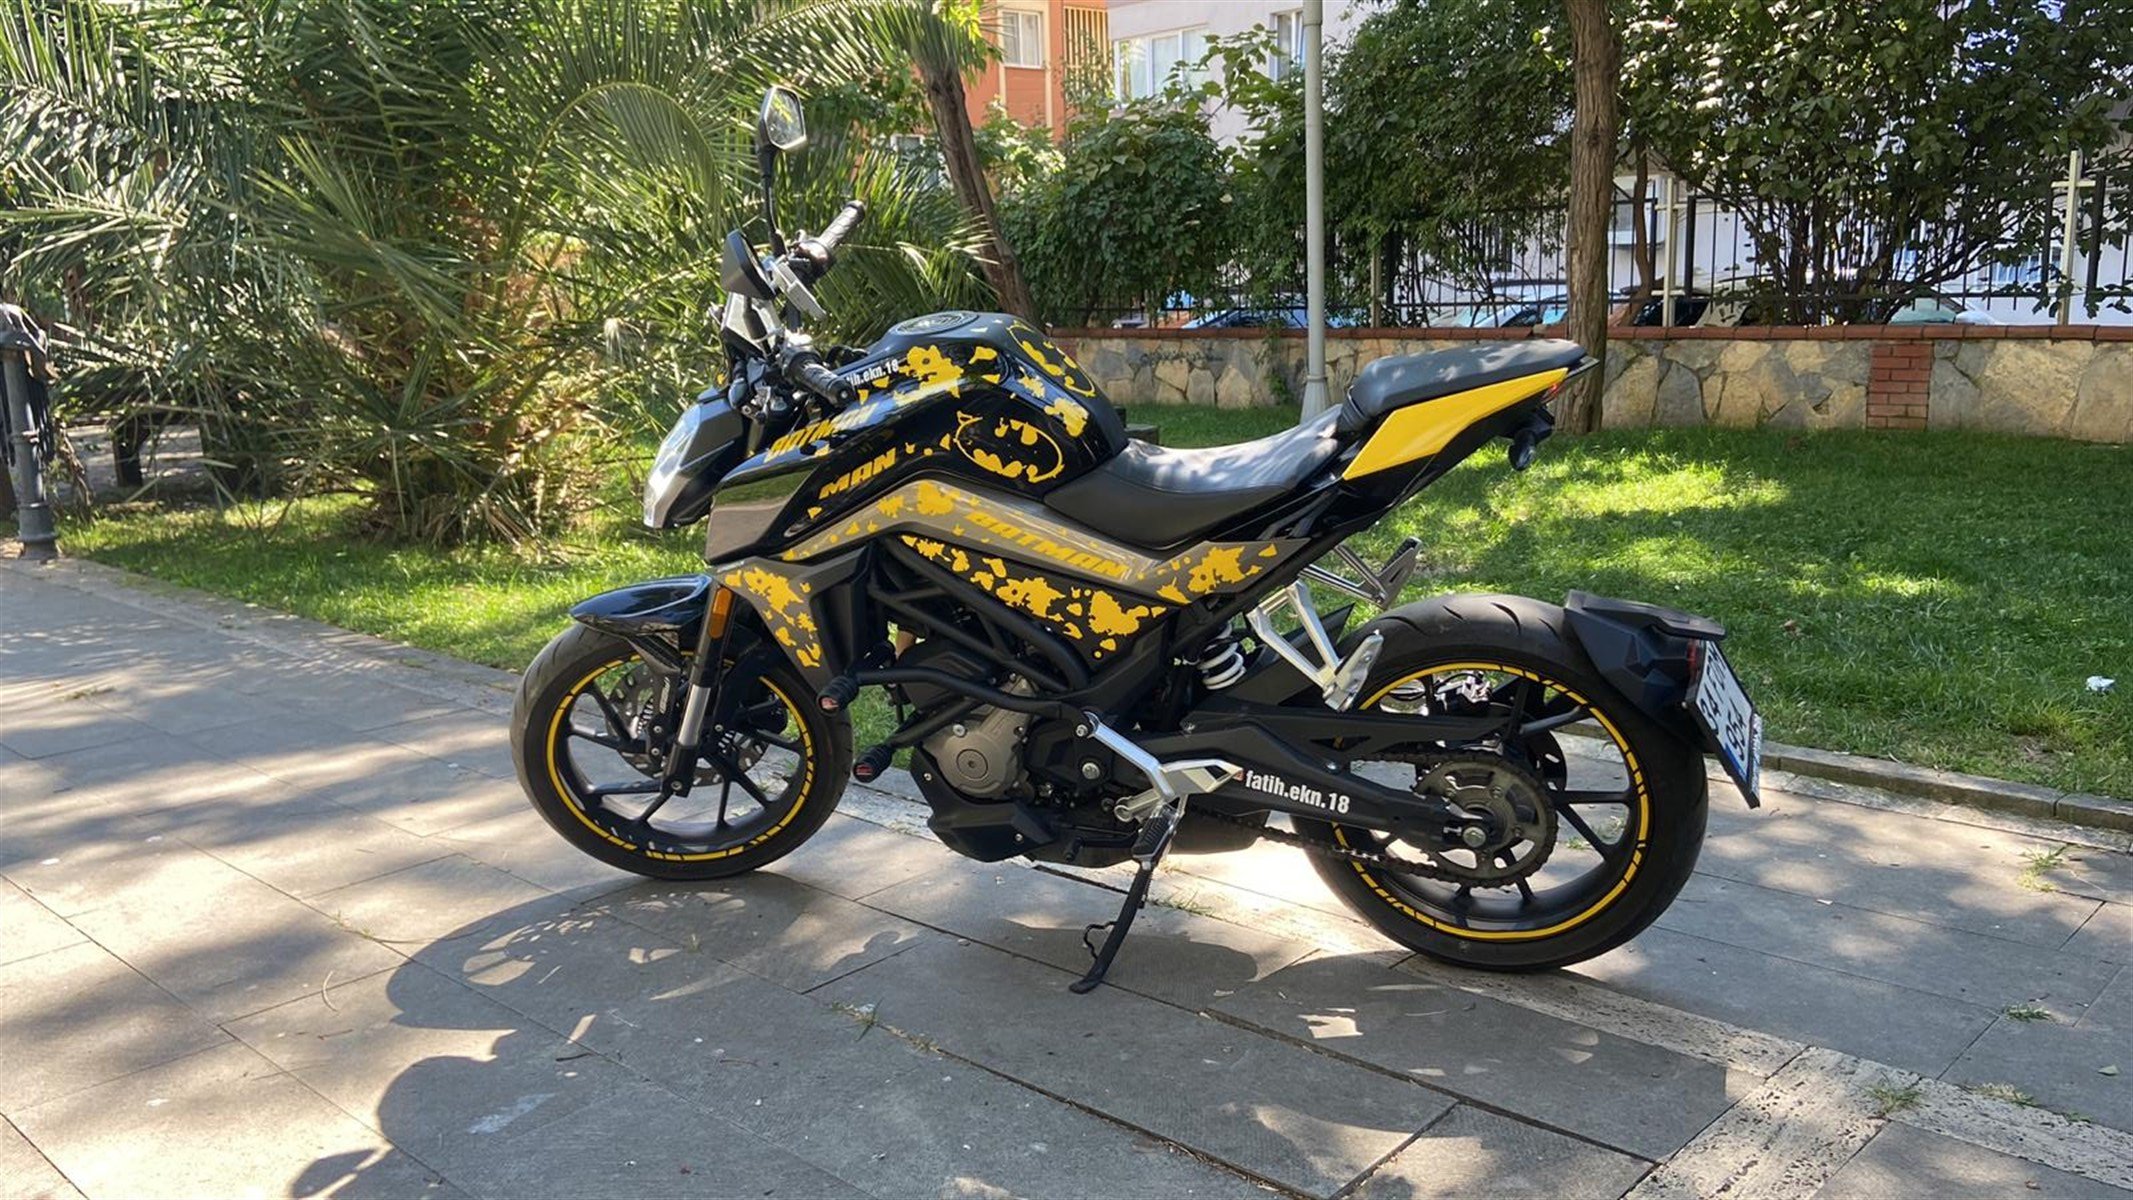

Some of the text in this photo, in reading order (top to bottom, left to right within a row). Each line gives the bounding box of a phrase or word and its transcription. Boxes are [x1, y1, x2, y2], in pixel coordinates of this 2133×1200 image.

[818, 447, 897, 500] MAN
[965, 511, 1131, 578] BATMAN
[1700, 682, 1721, 736] 34
[1725, 696, 1747, 762] 954
[1245, 769, 1350, 814] fatih.ekn.18
